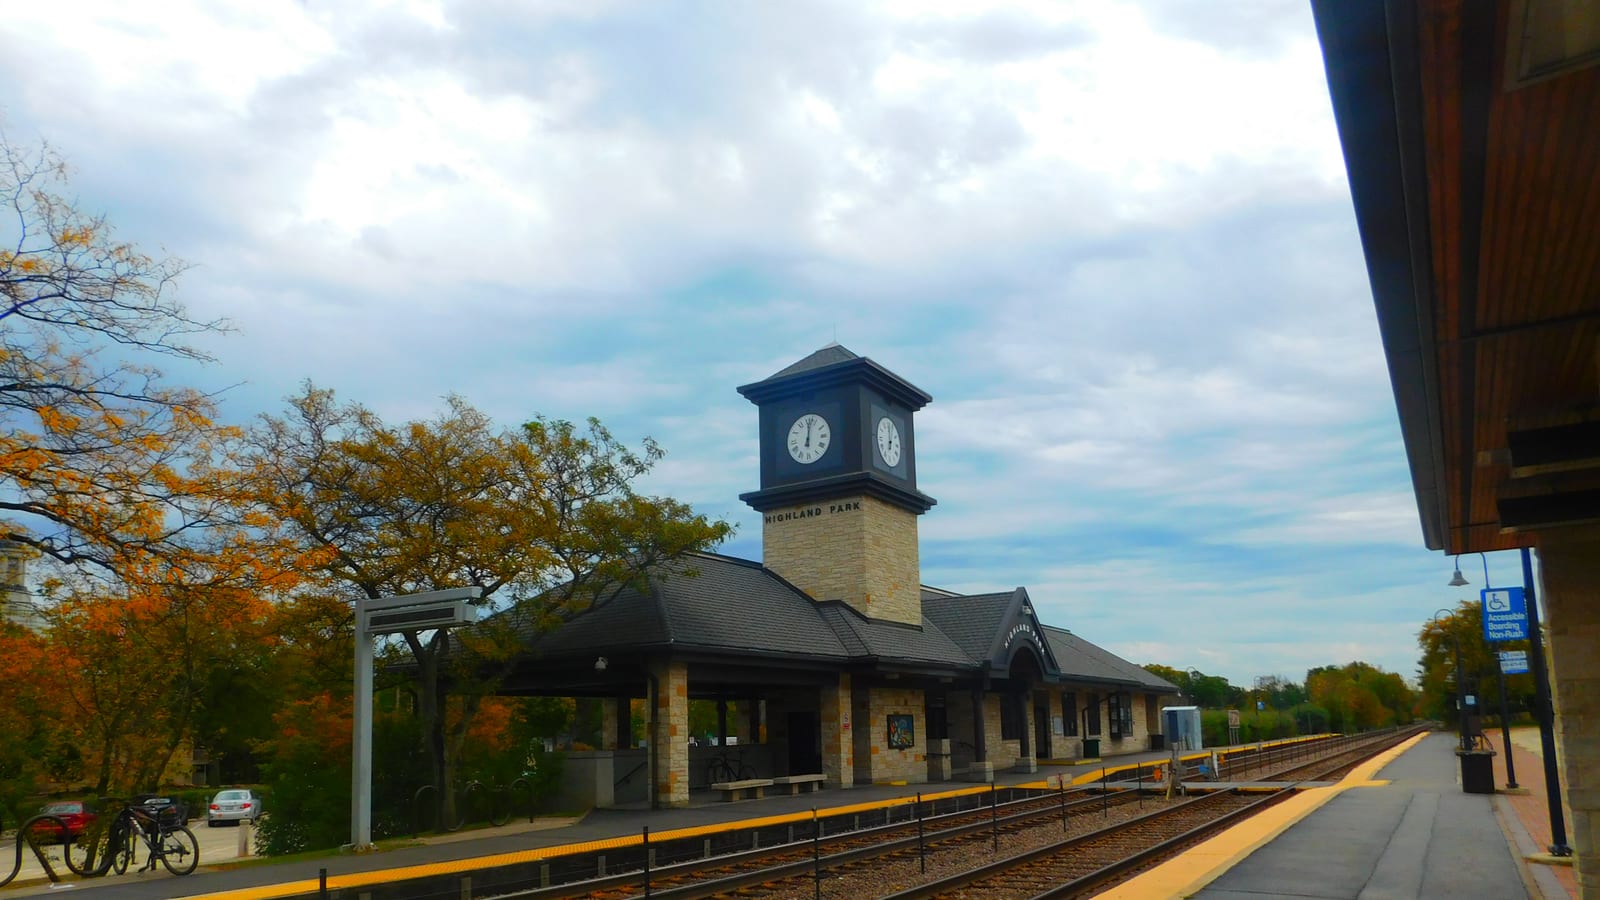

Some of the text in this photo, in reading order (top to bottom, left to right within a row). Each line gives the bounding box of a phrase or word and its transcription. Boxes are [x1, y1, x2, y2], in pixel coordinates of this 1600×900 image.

[764, 501, 860, 524] HIGHLAND PARK
[1488, 612, 1525, 622] Accessible
[1488, 621, 1520, 631] Boarding
[1489, 630, 1524, 639] Non-Rush
